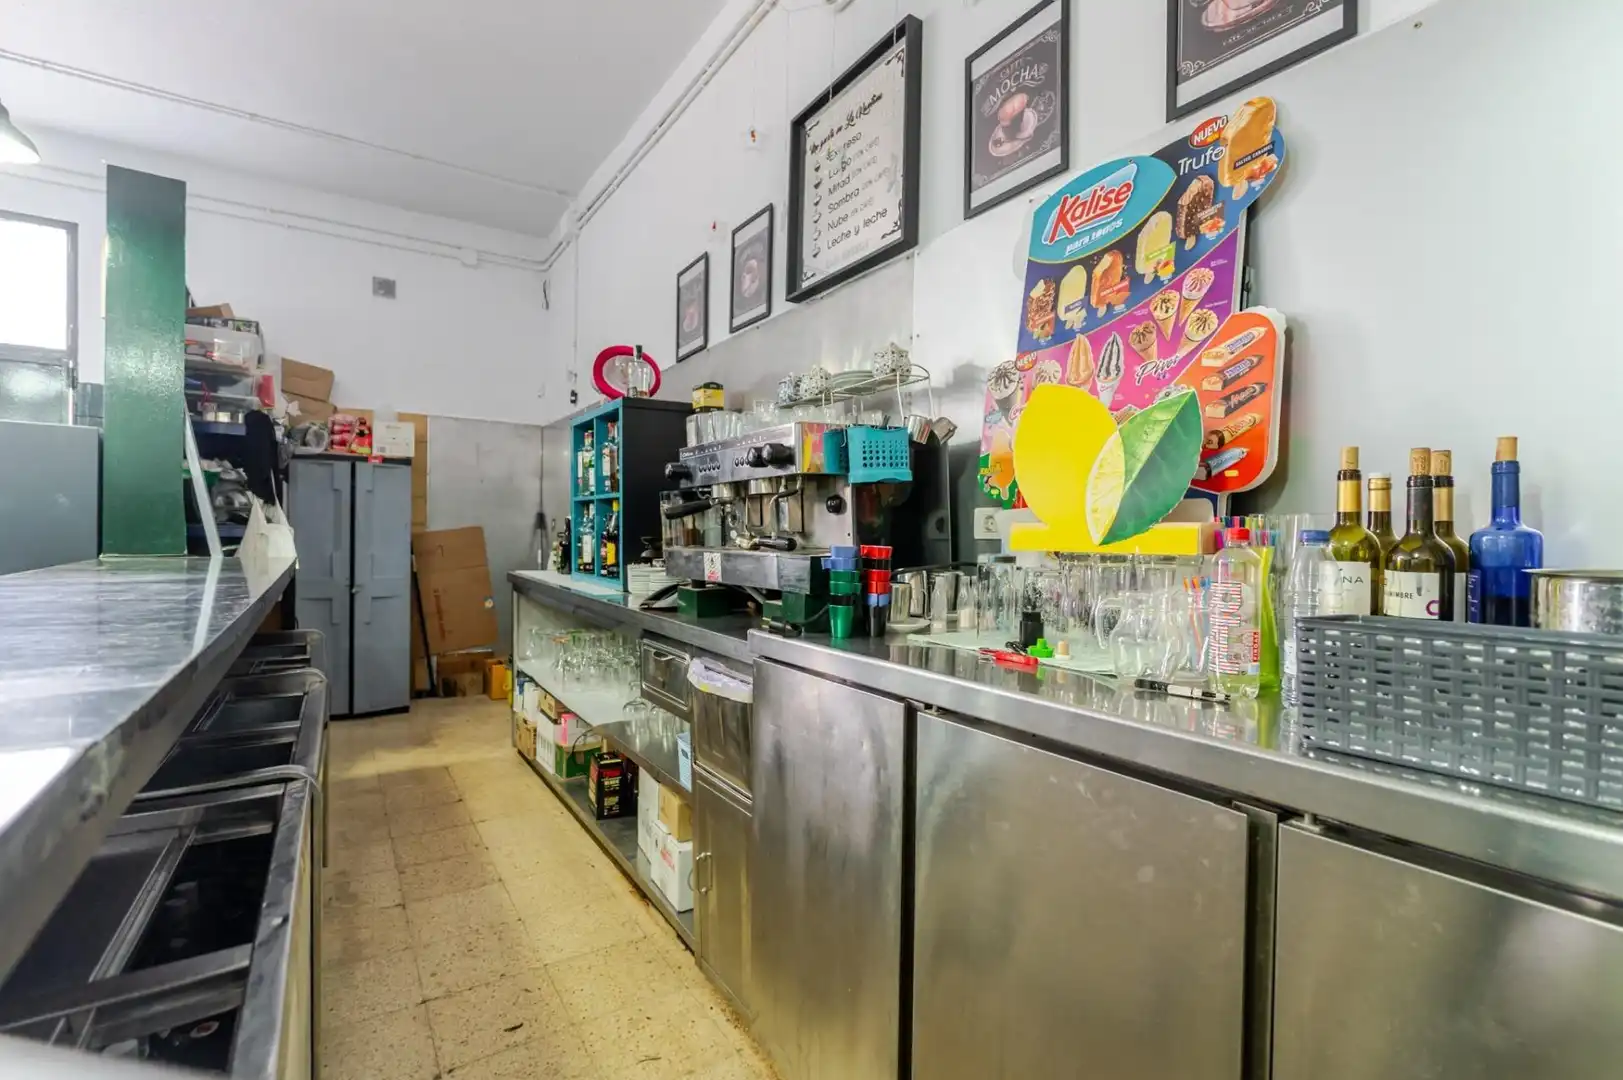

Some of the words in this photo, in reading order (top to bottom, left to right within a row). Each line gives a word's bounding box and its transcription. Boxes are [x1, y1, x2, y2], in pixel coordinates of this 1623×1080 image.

[989, 63, 1038, 106] MOCHA
[1193, 115, 1227, 145] NUEVO
[827, 132, 862, 162] Exreso
[828, 173, 850, 195] Mitad
[828, 188, 860, 214] Sombra
[1048, 181, 1133, 244] Kalise
[827, 213, 849, 231] Nube
[827, 230, 851, 250] Leche
[854, 224, 860, 236] y
[862, 208, 888, 229] leche
[1064, 235, 1091, 256] para
